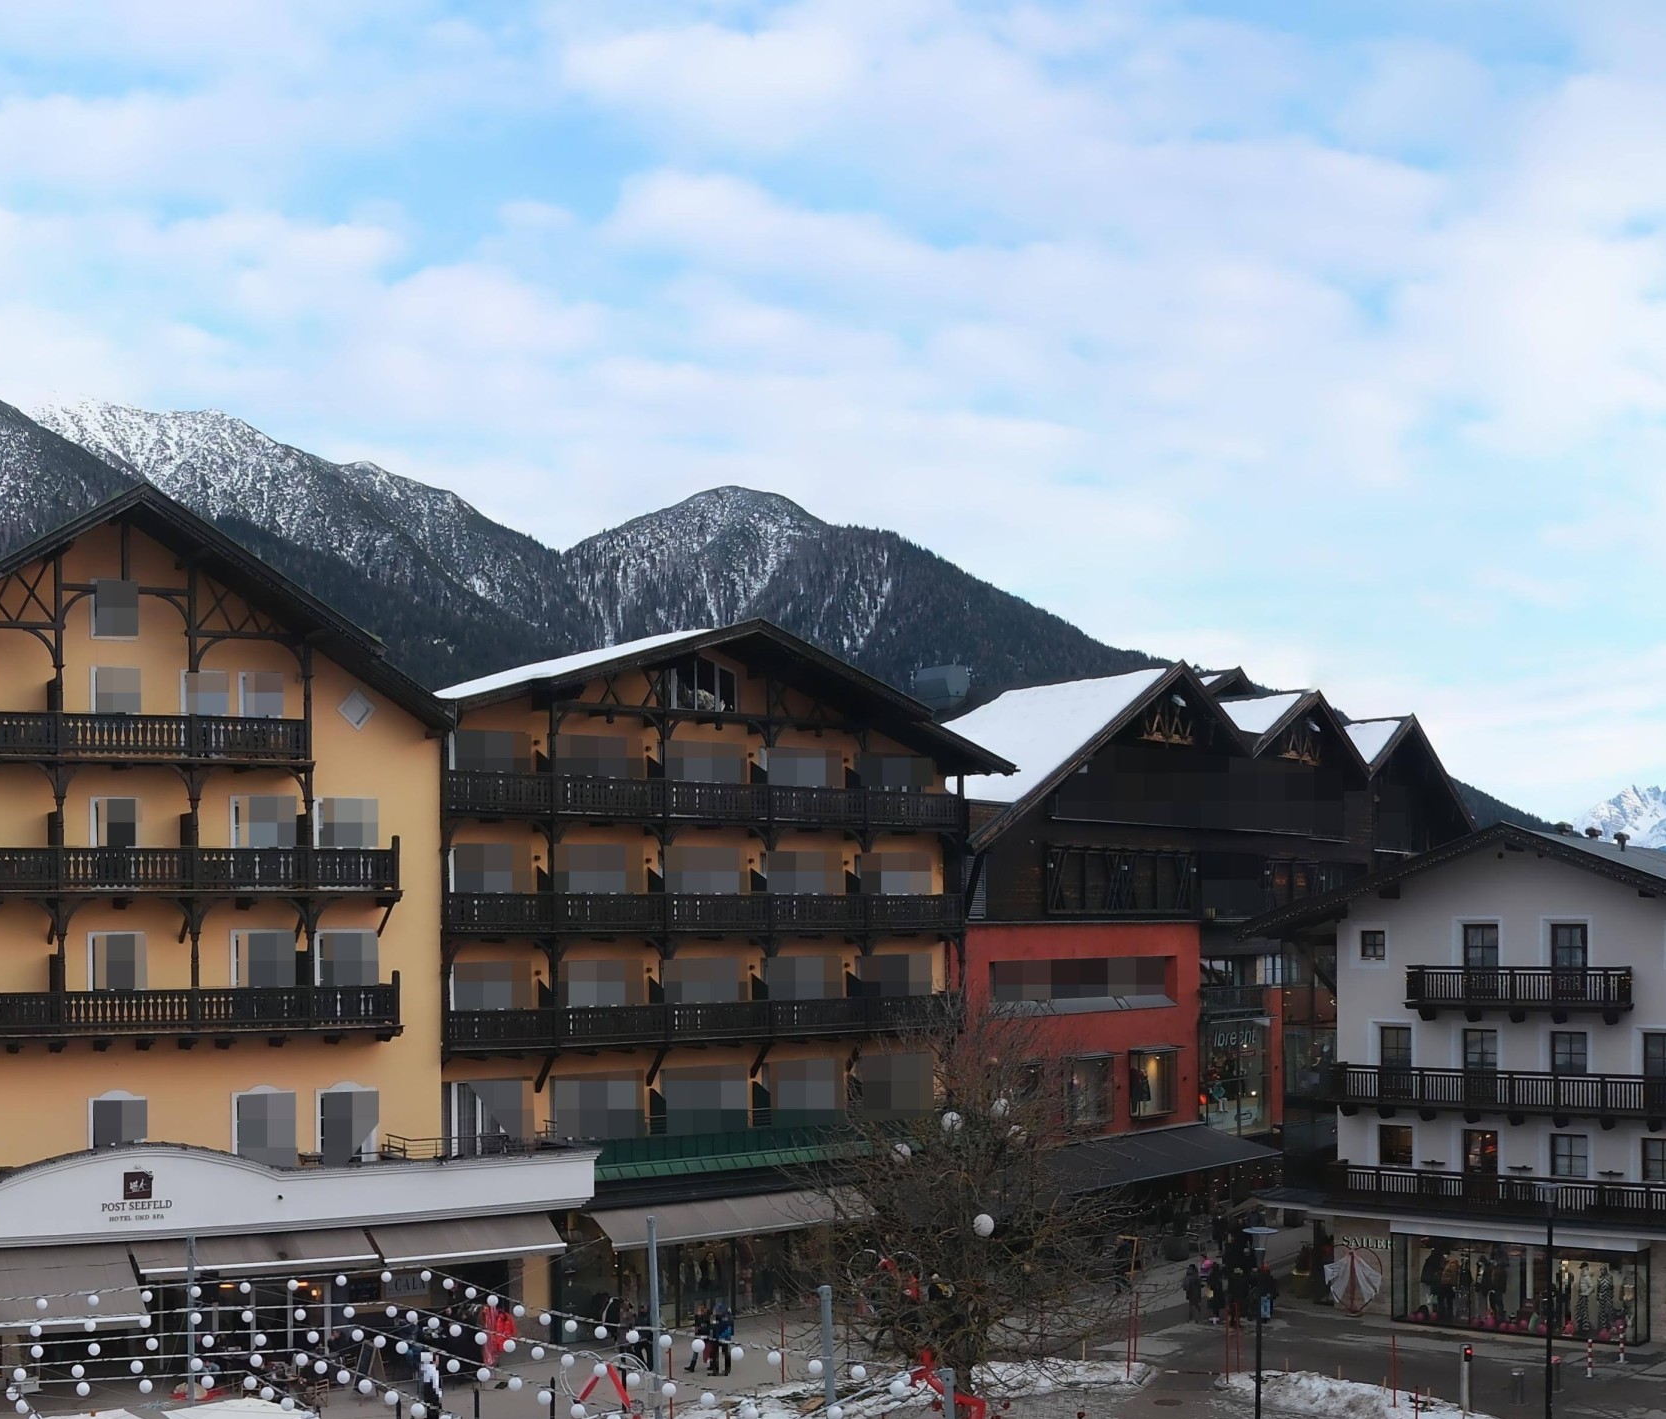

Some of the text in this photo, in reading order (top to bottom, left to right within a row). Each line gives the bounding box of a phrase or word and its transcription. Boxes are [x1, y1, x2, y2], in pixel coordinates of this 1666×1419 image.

[101, 1200, 172, 1212] POST SEEFELD
[1342, 1235, 1396, 1250] SAILER
